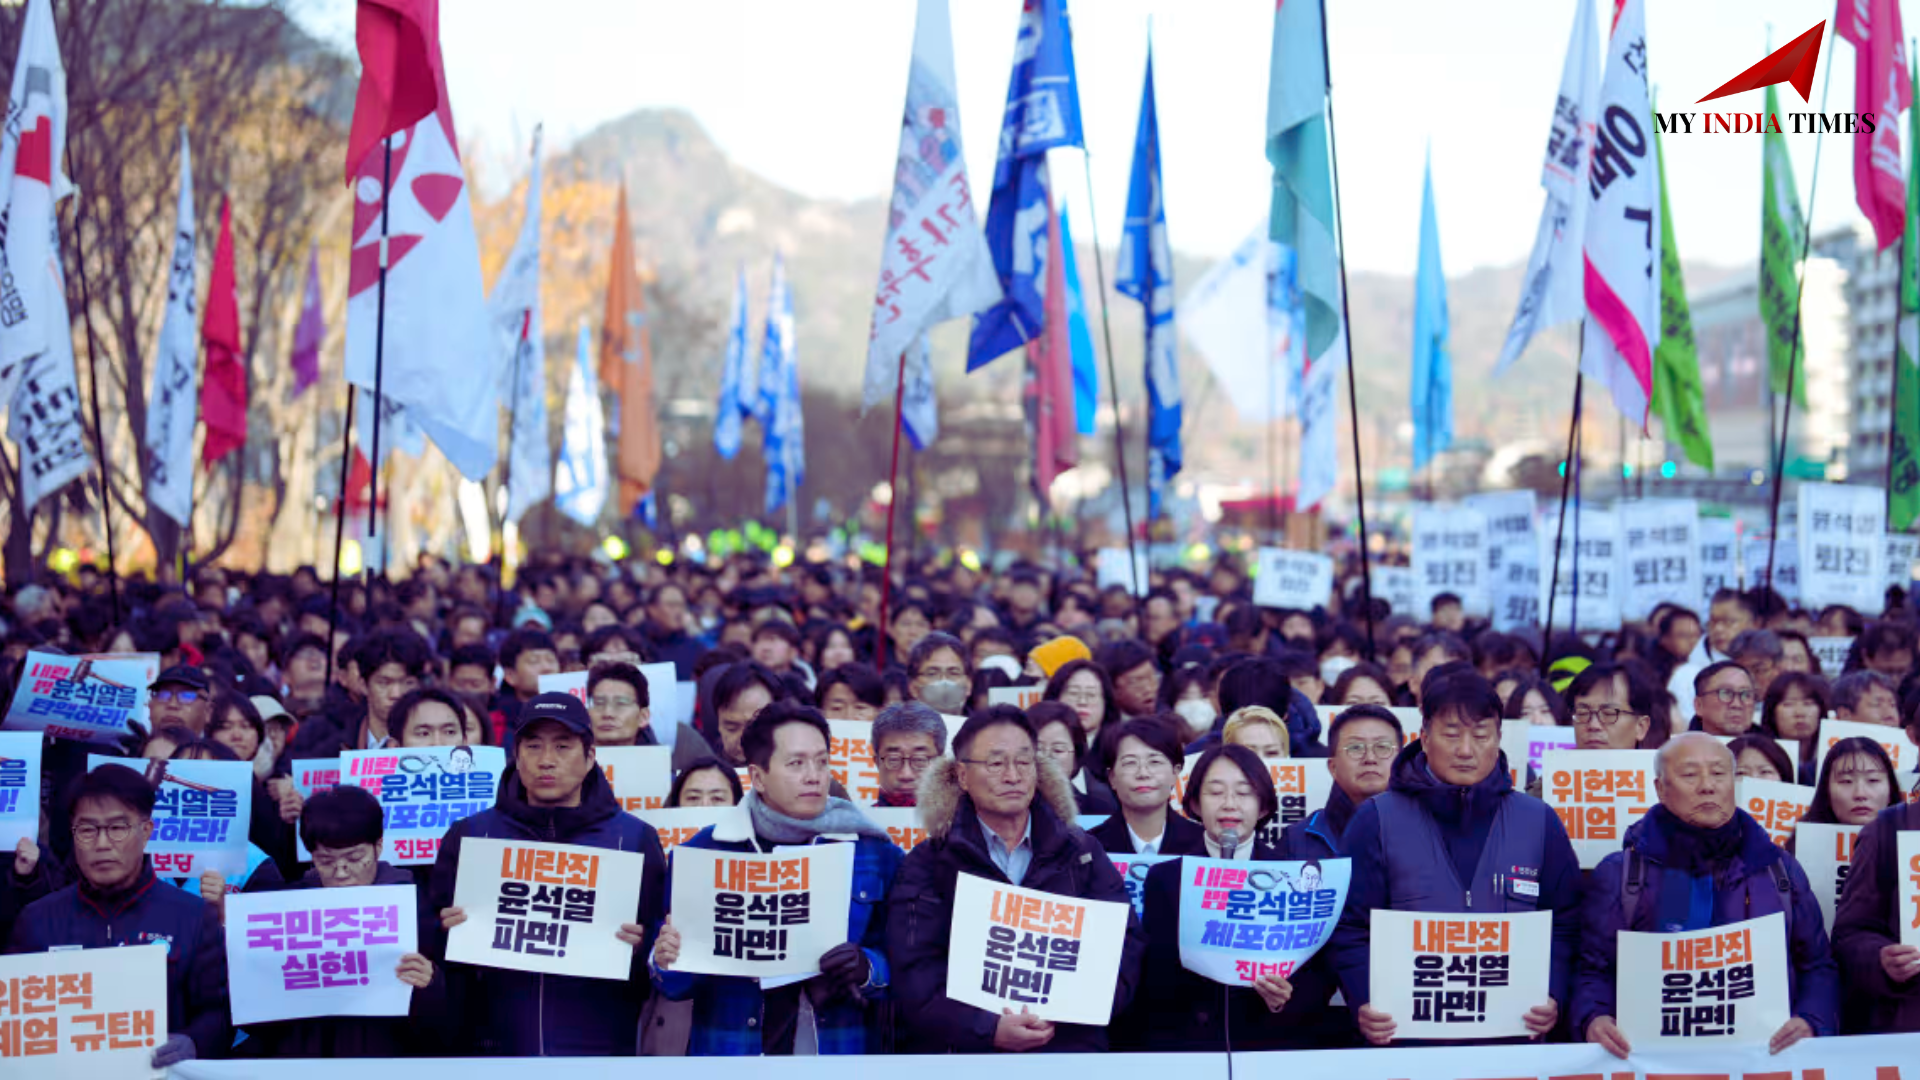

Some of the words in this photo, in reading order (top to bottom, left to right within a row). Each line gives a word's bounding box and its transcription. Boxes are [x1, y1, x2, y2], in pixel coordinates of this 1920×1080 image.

[351, 756, 399, 776] 내란
[154, 789, 238, 818] 석열을
[381, 771, 495, 802] 윤석열을
[1552, 769, 1646, 804] 위헌적
[153, 853, 195, 873] 보당
[394, 838, 442, 860] 진보
[501, 847, 599, 888] 내란죄
[714, 857, 810, 893] 내란죄
[1194, 866, 1248, 890] 내란
[497, 882, 596, 923] 윤석열
[714, 891, 810, 926] 윤석열
[990, 890, 1085, 939] 내란죄
[1226, 888, 1337, 922] 윤석열을
[246, 905, 399, 951] 국민주권
[491, 918, 570, 958] 파면!
[713, 927, 788, 962] 파면!
[1201, 919, 1327, 952] 체포하라!
[1413, 919, 1510, 954] 내란죄
[985, 926, 1080, 972] 윤석열
[1661, 928, 1752, 971] 내란죄
[281, 950, 370, 991] 실현!
[981, 960, 1053, 1005] 파면!
[1412, 954, 1510, 988] 윤석열
[1661, 963, 1755, 1004] 윤석열
[1412, 990, 1486, 1023] 파면!
[1660, 1003, 1735, 1037] 파면!
[70, 1010, 155, 1052] 규탄!
